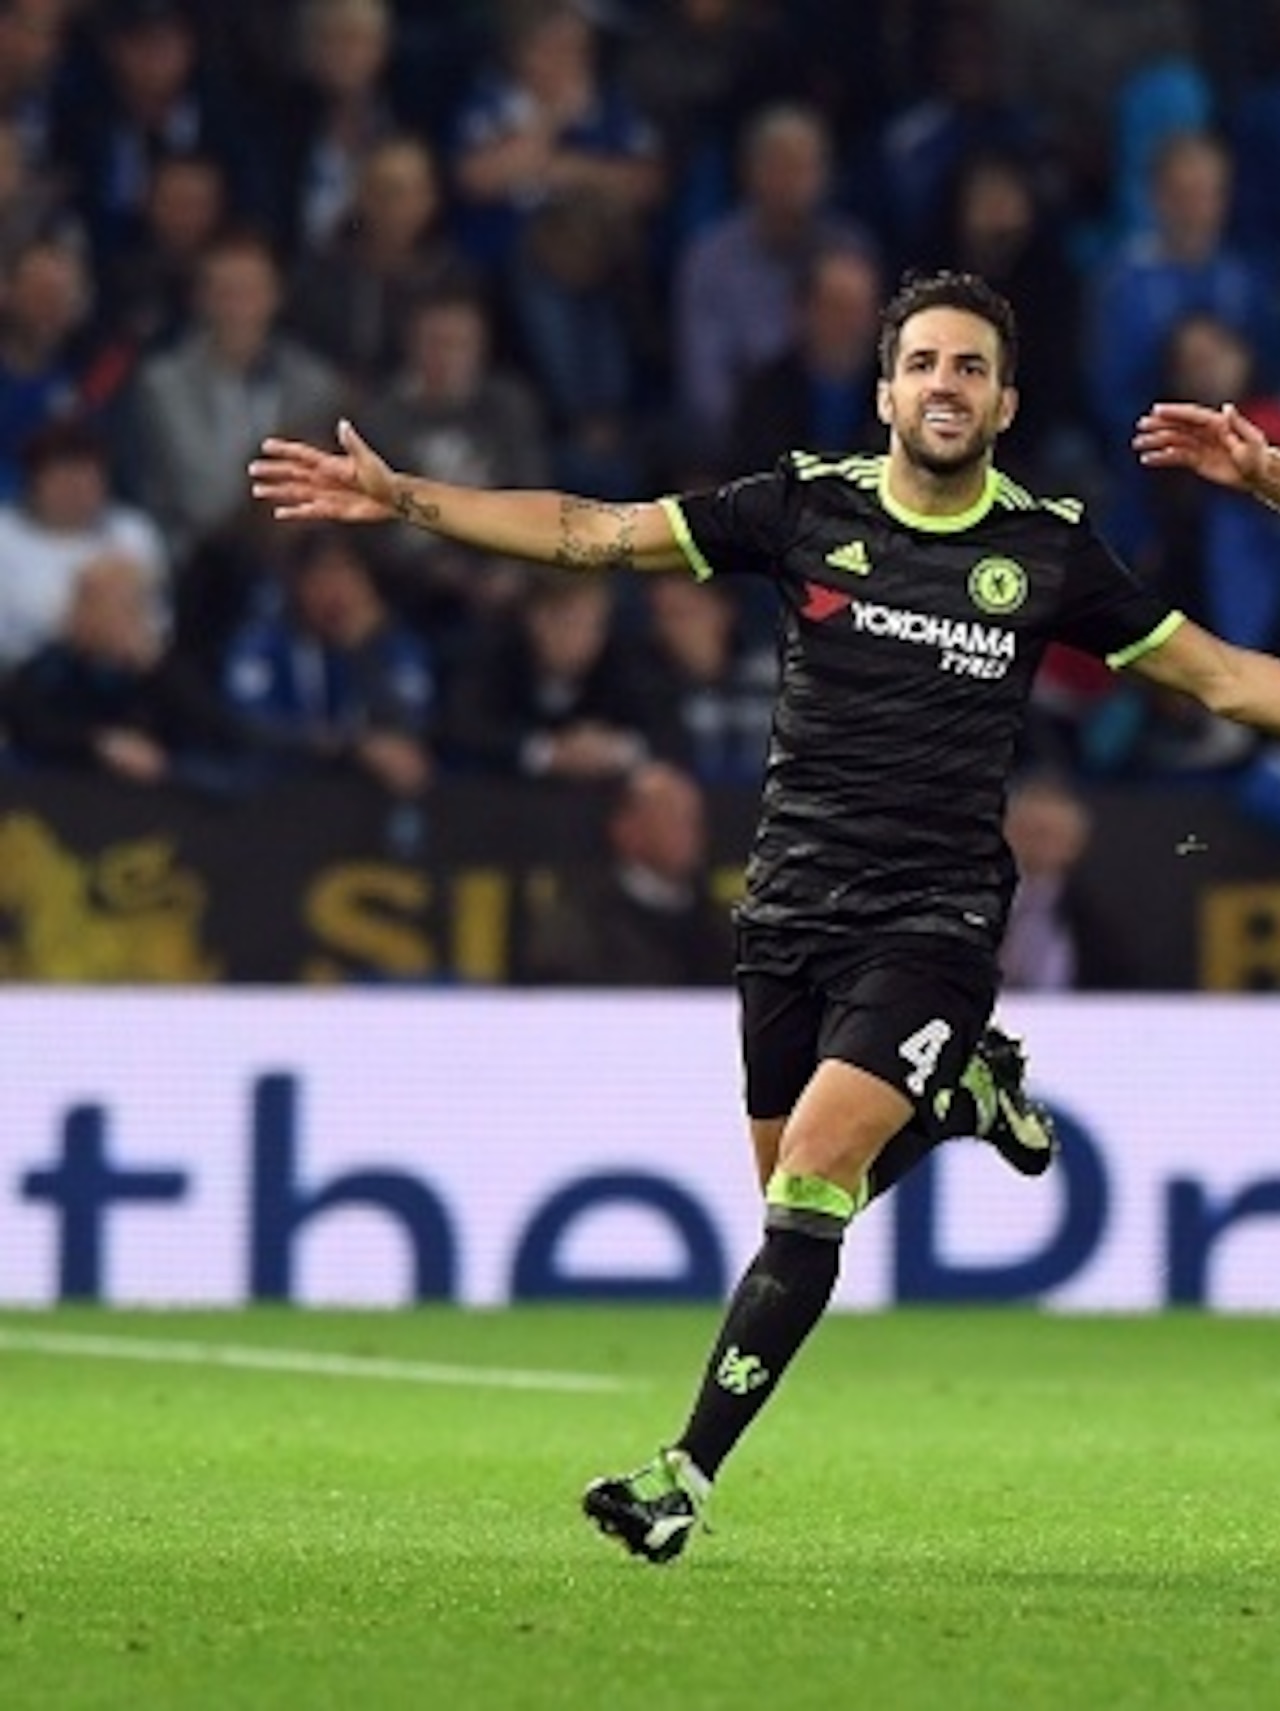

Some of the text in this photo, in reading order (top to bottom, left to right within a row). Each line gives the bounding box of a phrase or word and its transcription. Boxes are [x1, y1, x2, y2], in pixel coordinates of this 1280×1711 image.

[851, 600, 1017, 660] YOKOHAMA
[938, 651, 1011, 680] TYRES
[899, 1018, 952, 1097] 4
[19, 1068, 730, 1304] the
